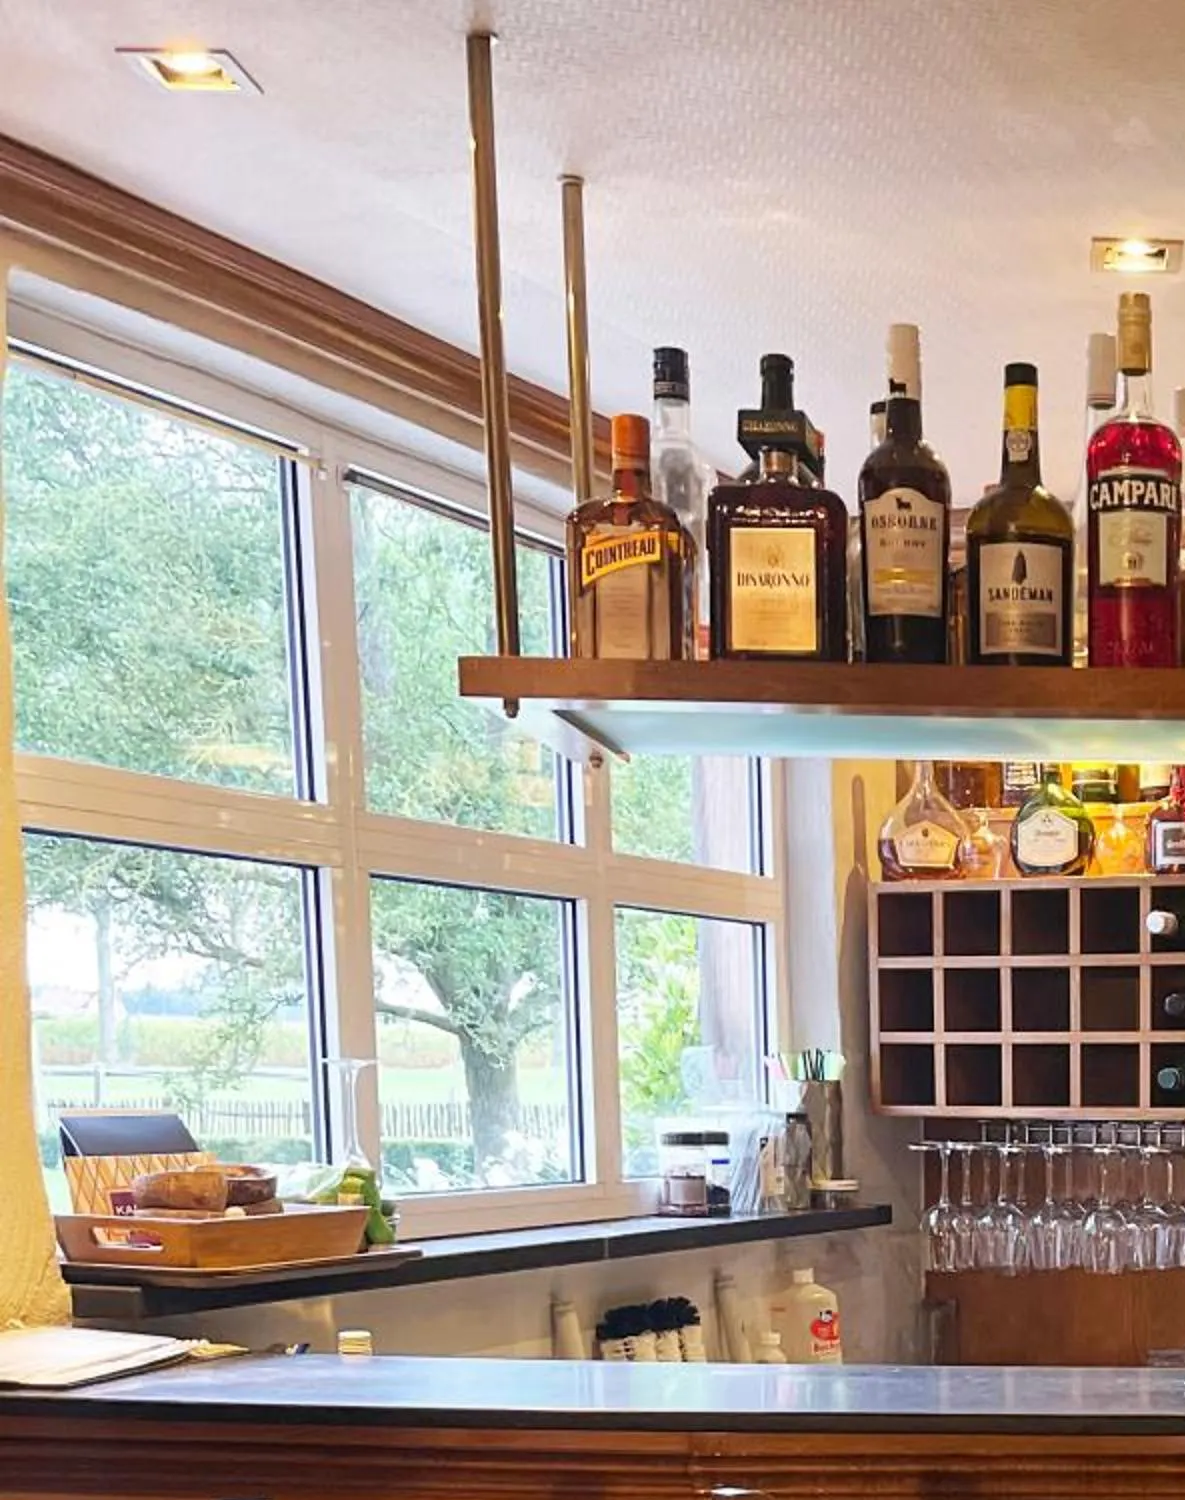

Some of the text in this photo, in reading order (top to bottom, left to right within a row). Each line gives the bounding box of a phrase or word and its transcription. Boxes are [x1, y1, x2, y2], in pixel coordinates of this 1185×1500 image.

[1088, 479, 1178, 512] CAMPARI
[871, 514, 938, 531] OSBORNE
[737, 571, 811, 588] DISARONNO
[987, 586, 1054, 604] SANDEMAN
